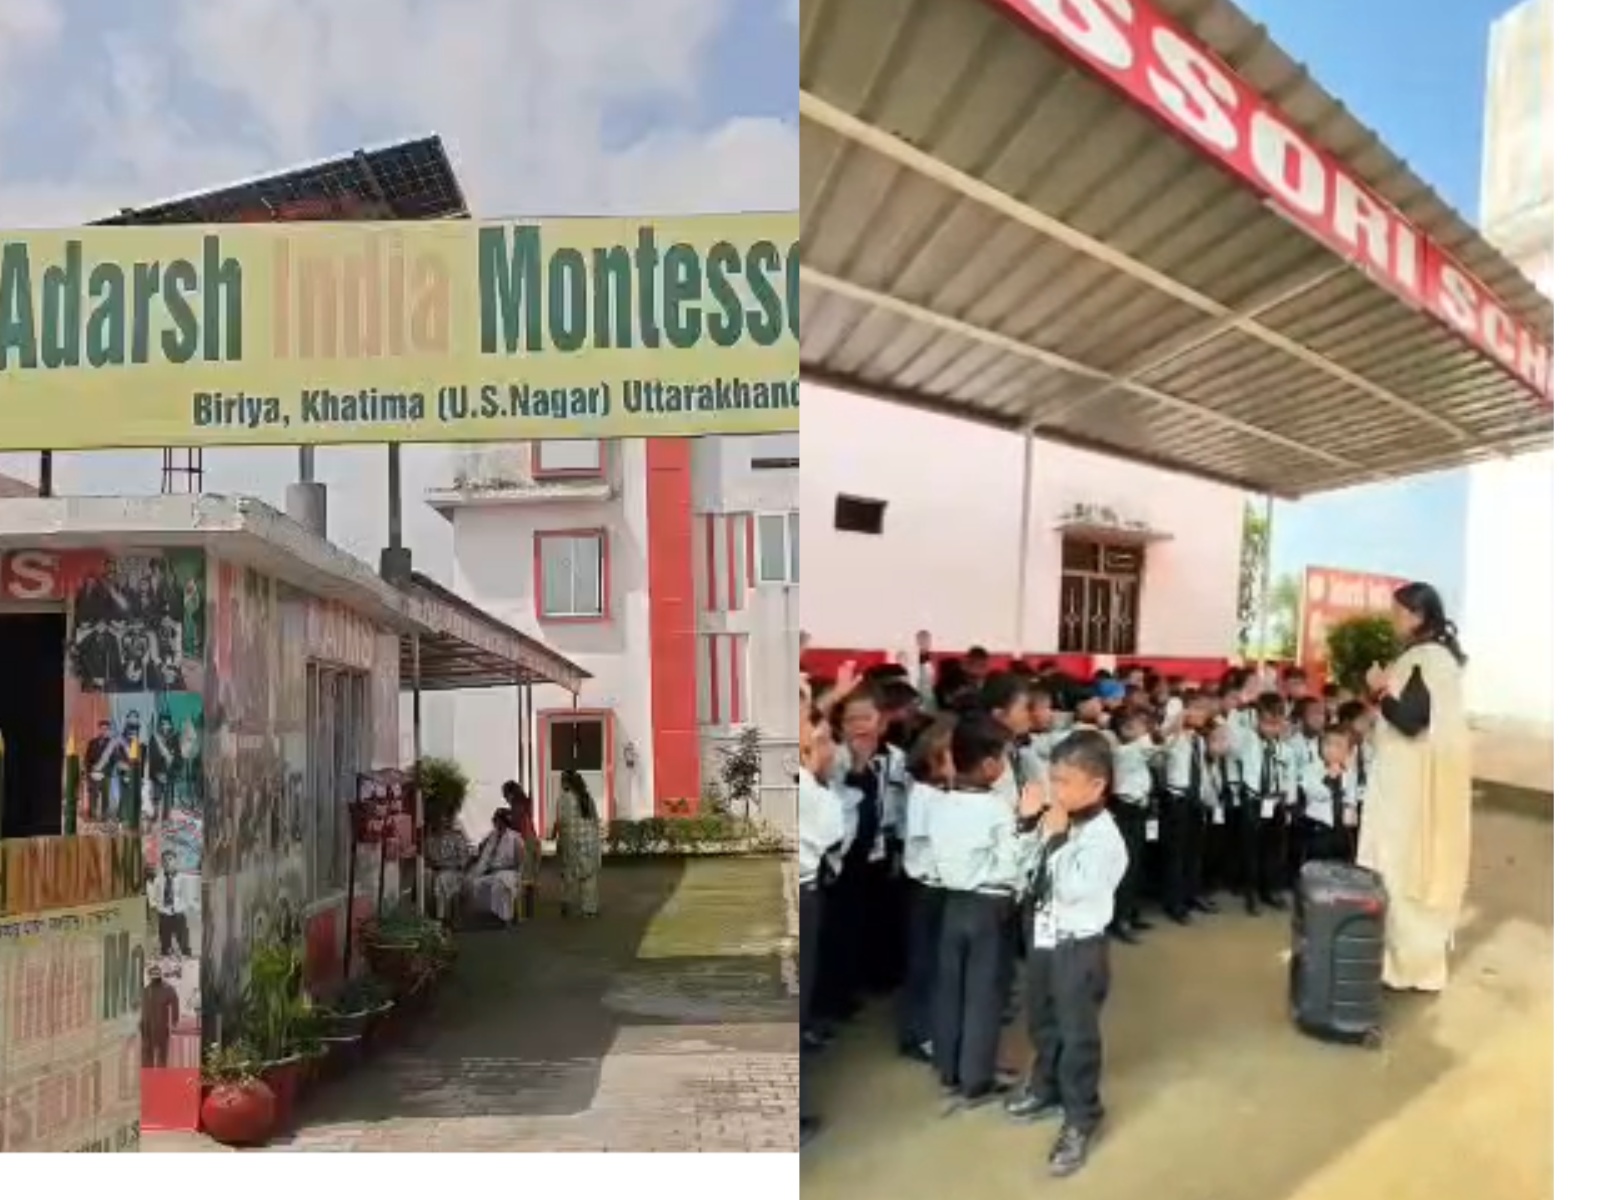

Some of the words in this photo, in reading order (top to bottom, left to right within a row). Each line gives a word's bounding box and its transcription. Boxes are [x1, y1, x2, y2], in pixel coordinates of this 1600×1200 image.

[0, 235, 242, 369] Adarsh
[272, 237, 450, 360] India
[1439, 264, 1554, 400] SCH
[301, 388, 424, 422] Khatima
[438, 382, 610, 421] (U.S.Nagar)
